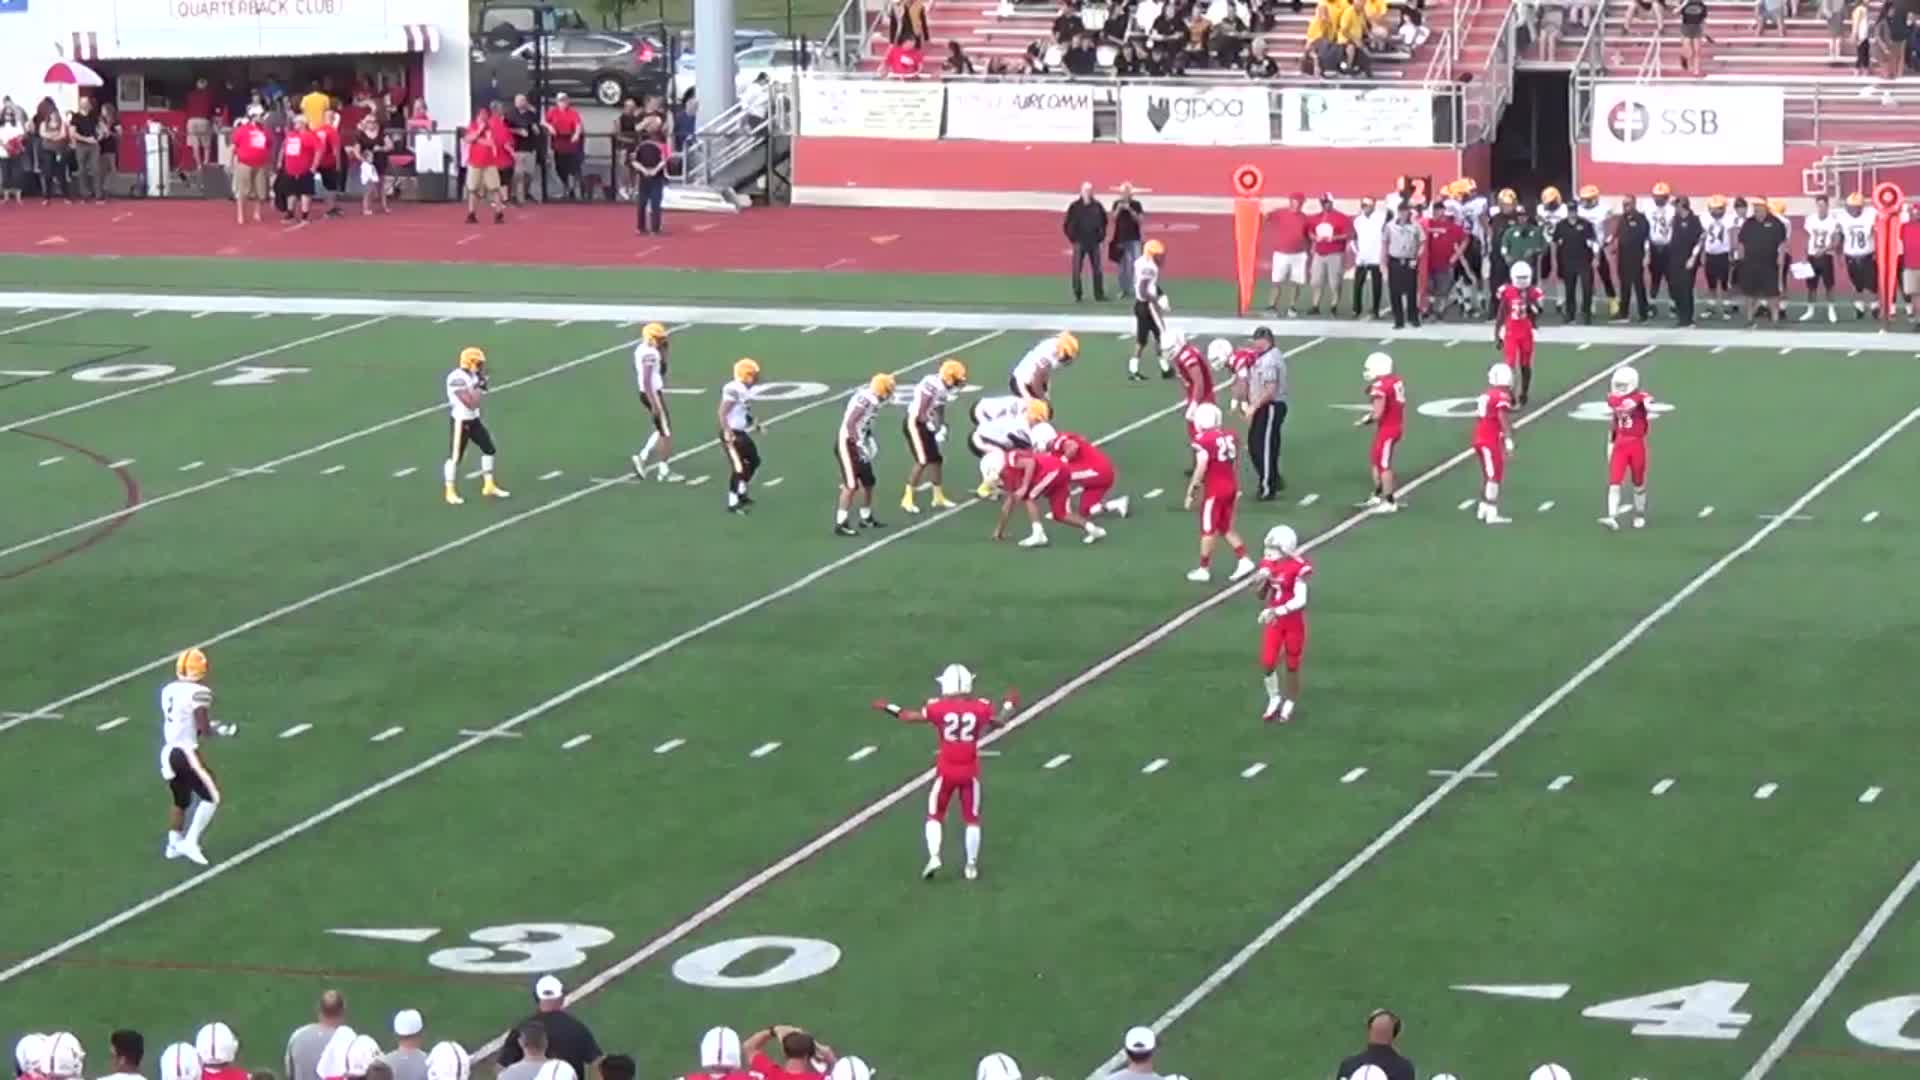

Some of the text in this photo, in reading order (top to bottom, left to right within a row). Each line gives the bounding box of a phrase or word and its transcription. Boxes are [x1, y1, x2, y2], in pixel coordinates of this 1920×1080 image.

[295, 0, 335, 15] CLUB
[1173, 96, 1244, 123] gpoa
[1660, 108, 1719, 135] SSB
[1410, 178, 1427, 206] 2
[1215, 434, 1237, 463] 25
[943, 712, 977, 742] 22
